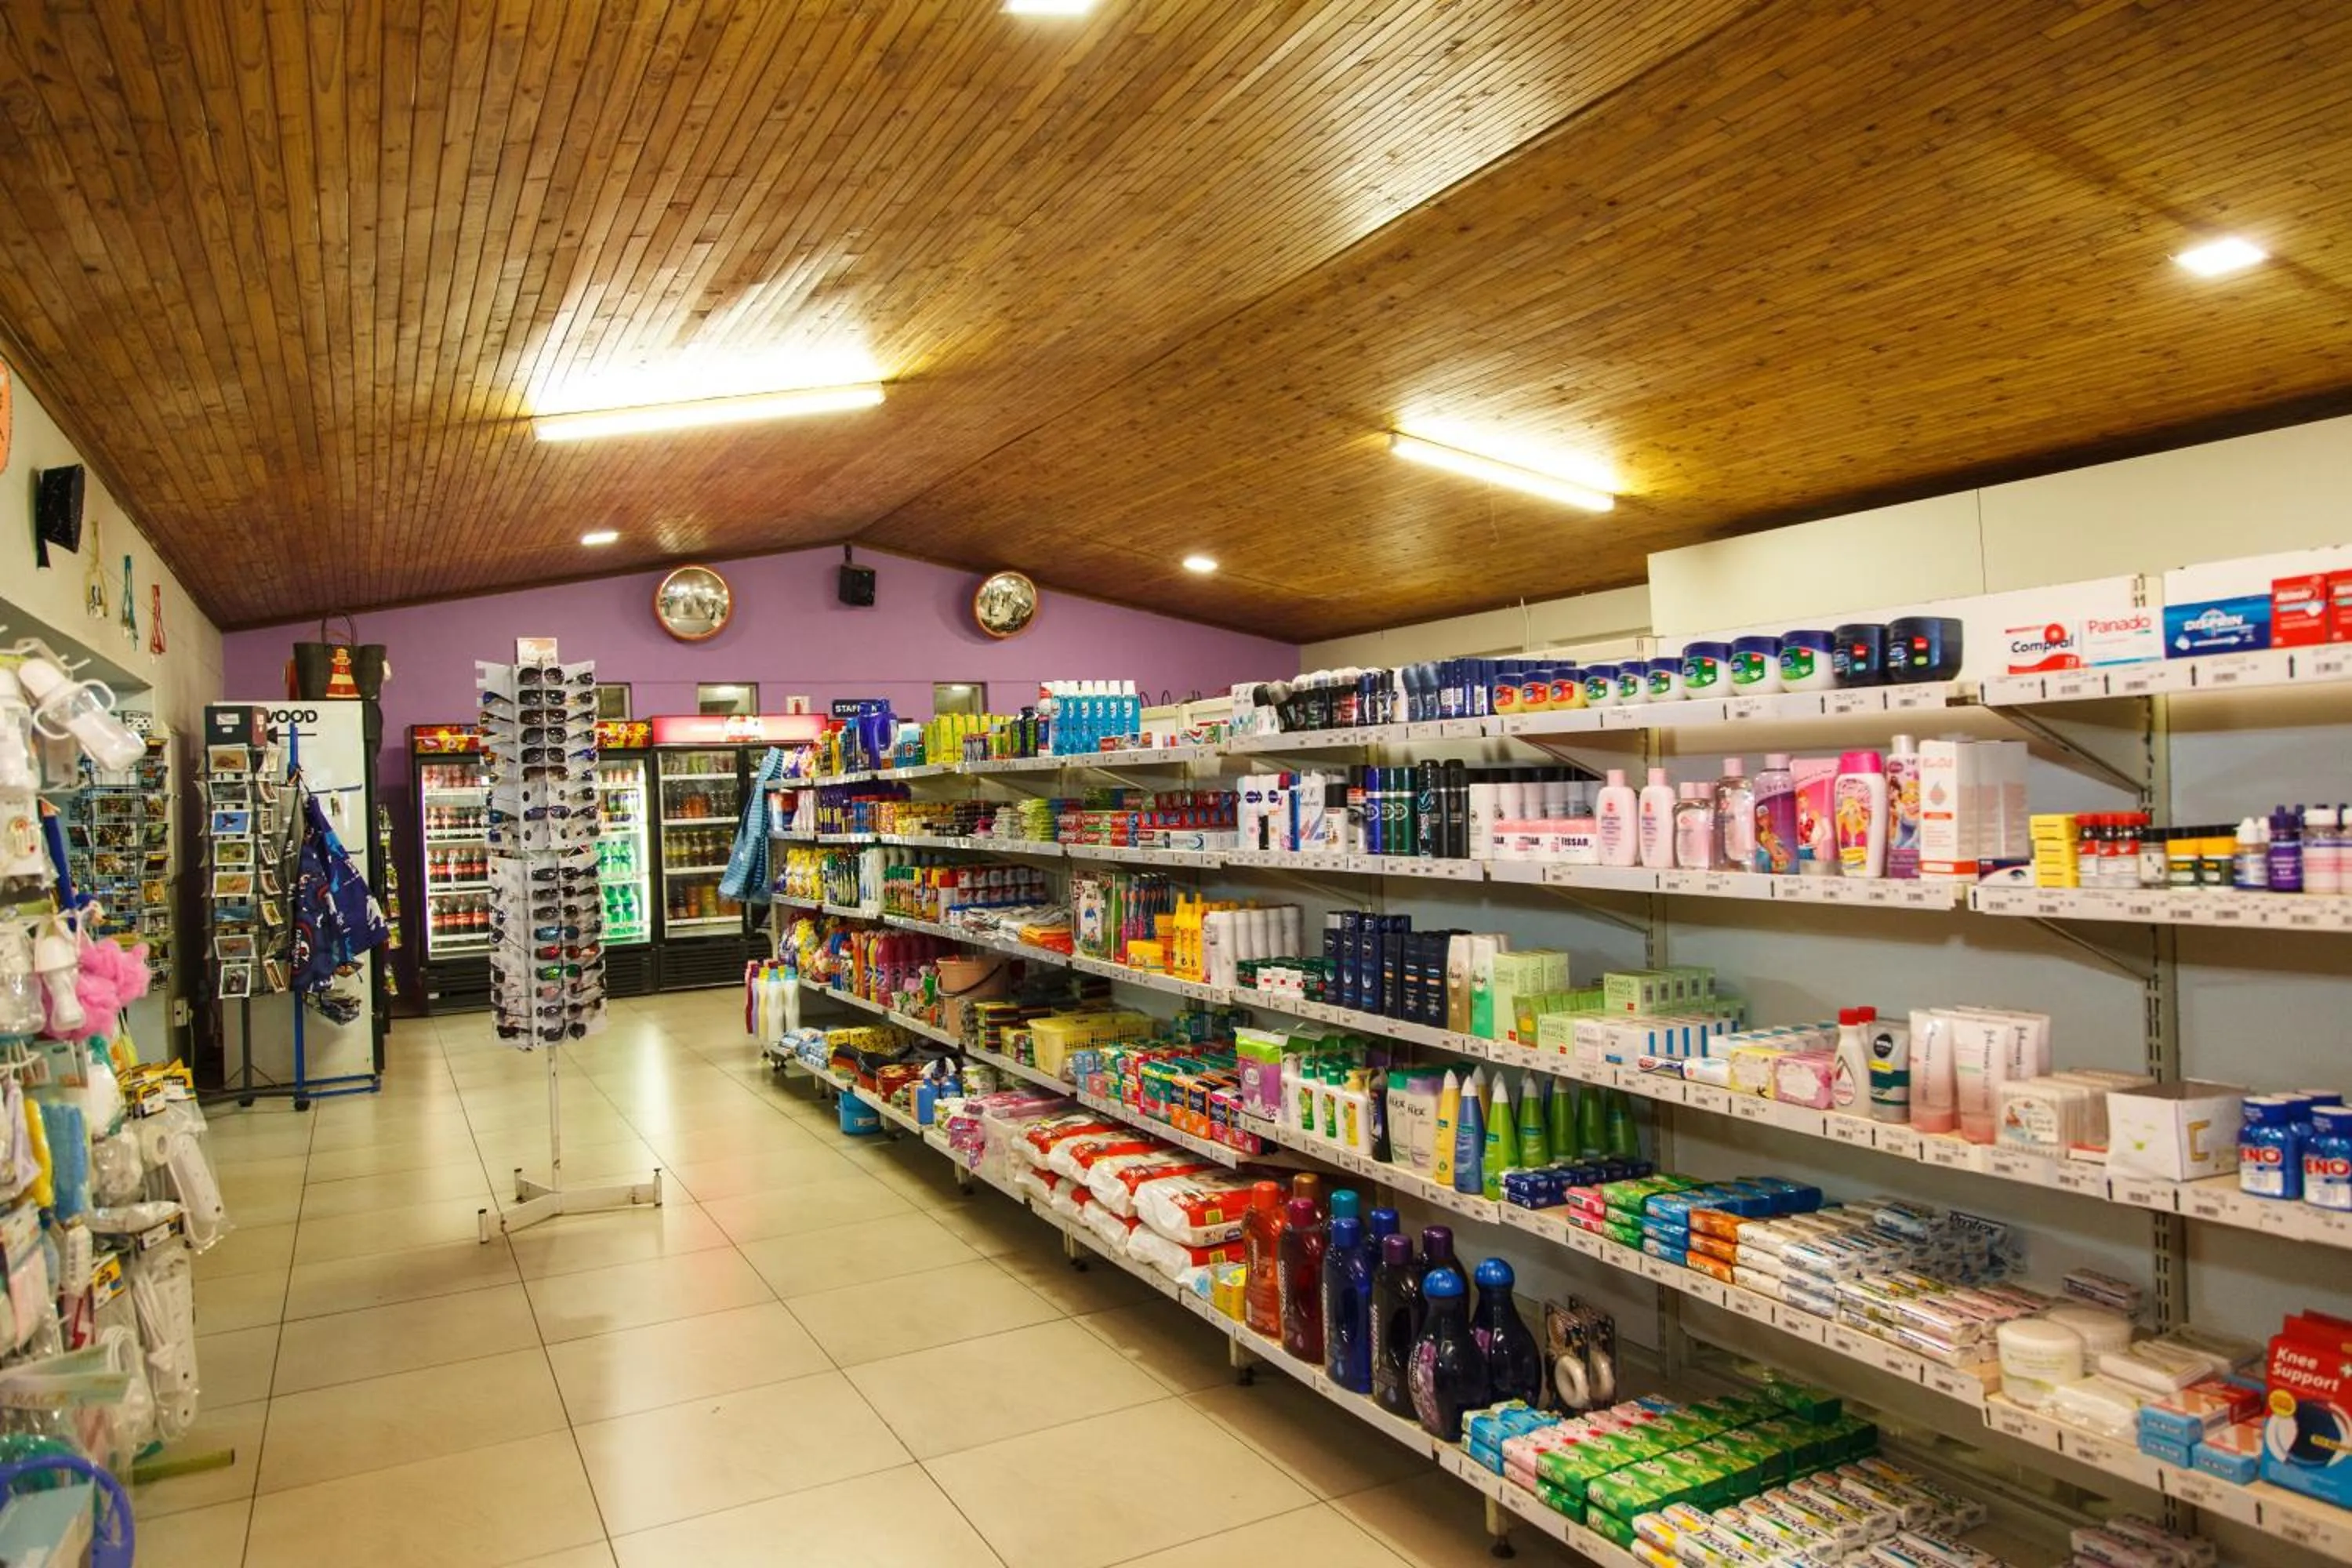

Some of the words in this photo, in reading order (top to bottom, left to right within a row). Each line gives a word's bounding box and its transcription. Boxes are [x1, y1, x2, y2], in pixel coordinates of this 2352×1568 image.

[2089, 615, 2151, 634] Panado
[2011, 634, 2074, 653] Compral
[2305, 1156, 2350, 1177] ENO
[2277, 1347, 2318, 1370] Knee
[2273, 1362, 2339, 1392] Support
